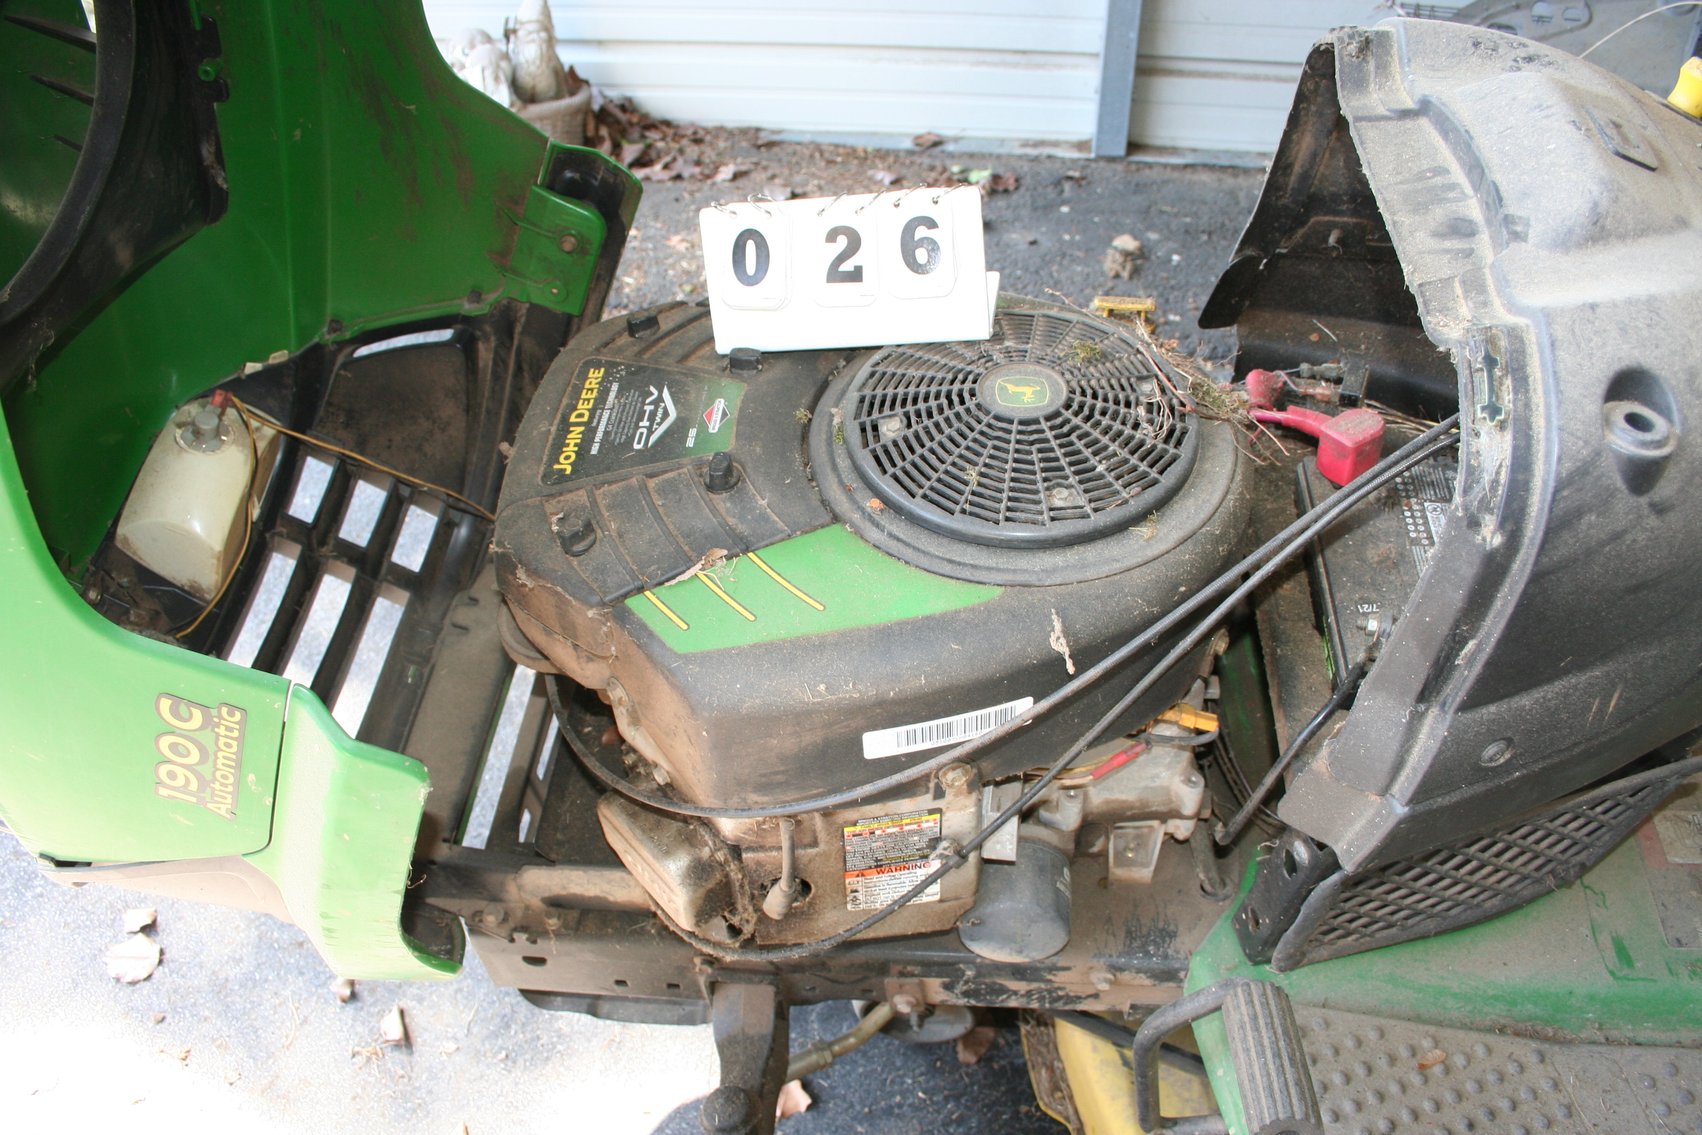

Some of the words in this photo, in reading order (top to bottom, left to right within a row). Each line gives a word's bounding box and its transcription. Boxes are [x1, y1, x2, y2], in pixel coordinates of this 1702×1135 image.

[553, 426, 585, 475] JOHN
[570, 367, 605, 422] DEERE
[633, 385, 658, 449] OHV
[652, 403, 665, 431] TWIN
[686, 428, 697, 447] 25
[207, 706, 241, 819] Automatic
[876, 861, 931, 875] WARNING
